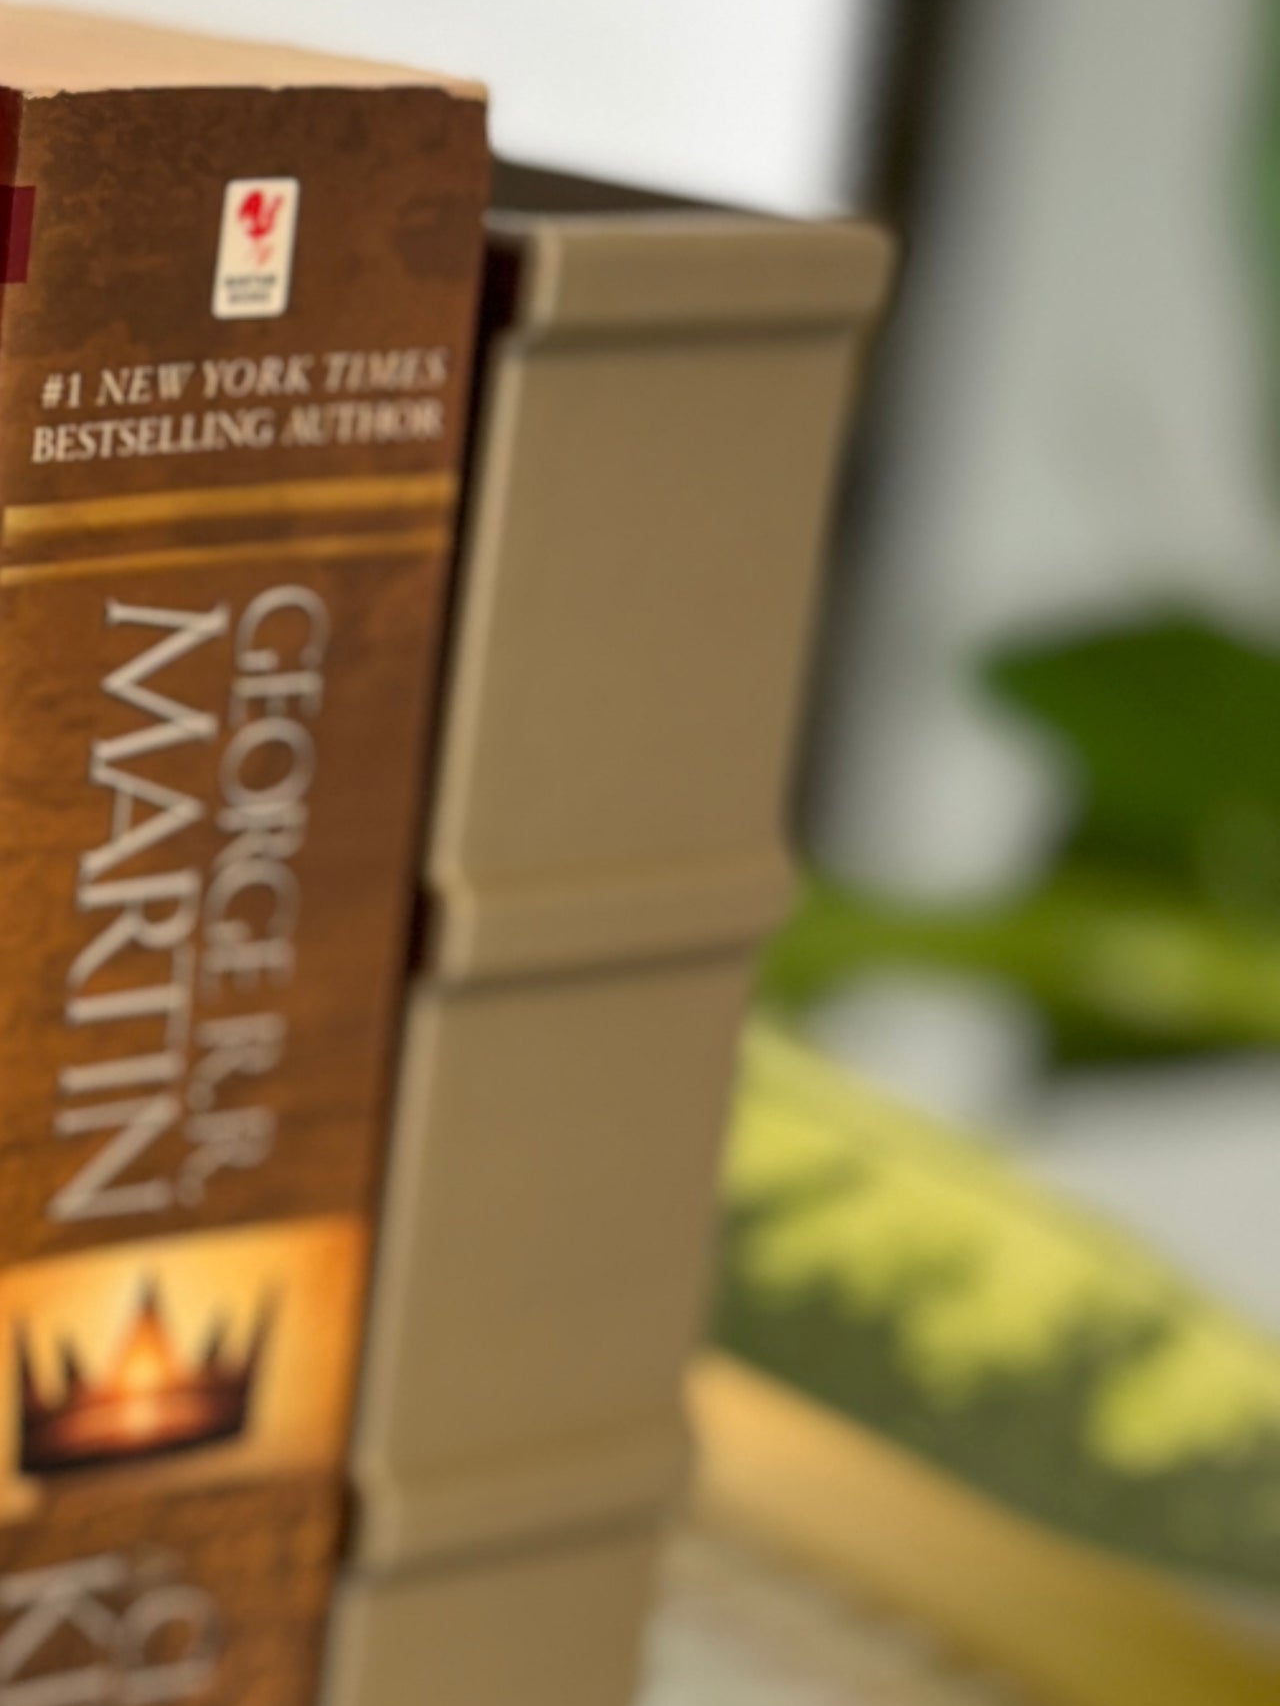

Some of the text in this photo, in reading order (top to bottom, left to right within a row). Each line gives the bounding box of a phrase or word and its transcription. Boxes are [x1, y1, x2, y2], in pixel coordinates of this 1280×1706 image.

[30, 397, 445, 465] BESTSELLING AUTHOR
[41, 347, 450, 409] #1 NEW YORK TIMES
[46, 597, 231, 1224] MARTIN
[197, 584, 331, 999] GEORGE
